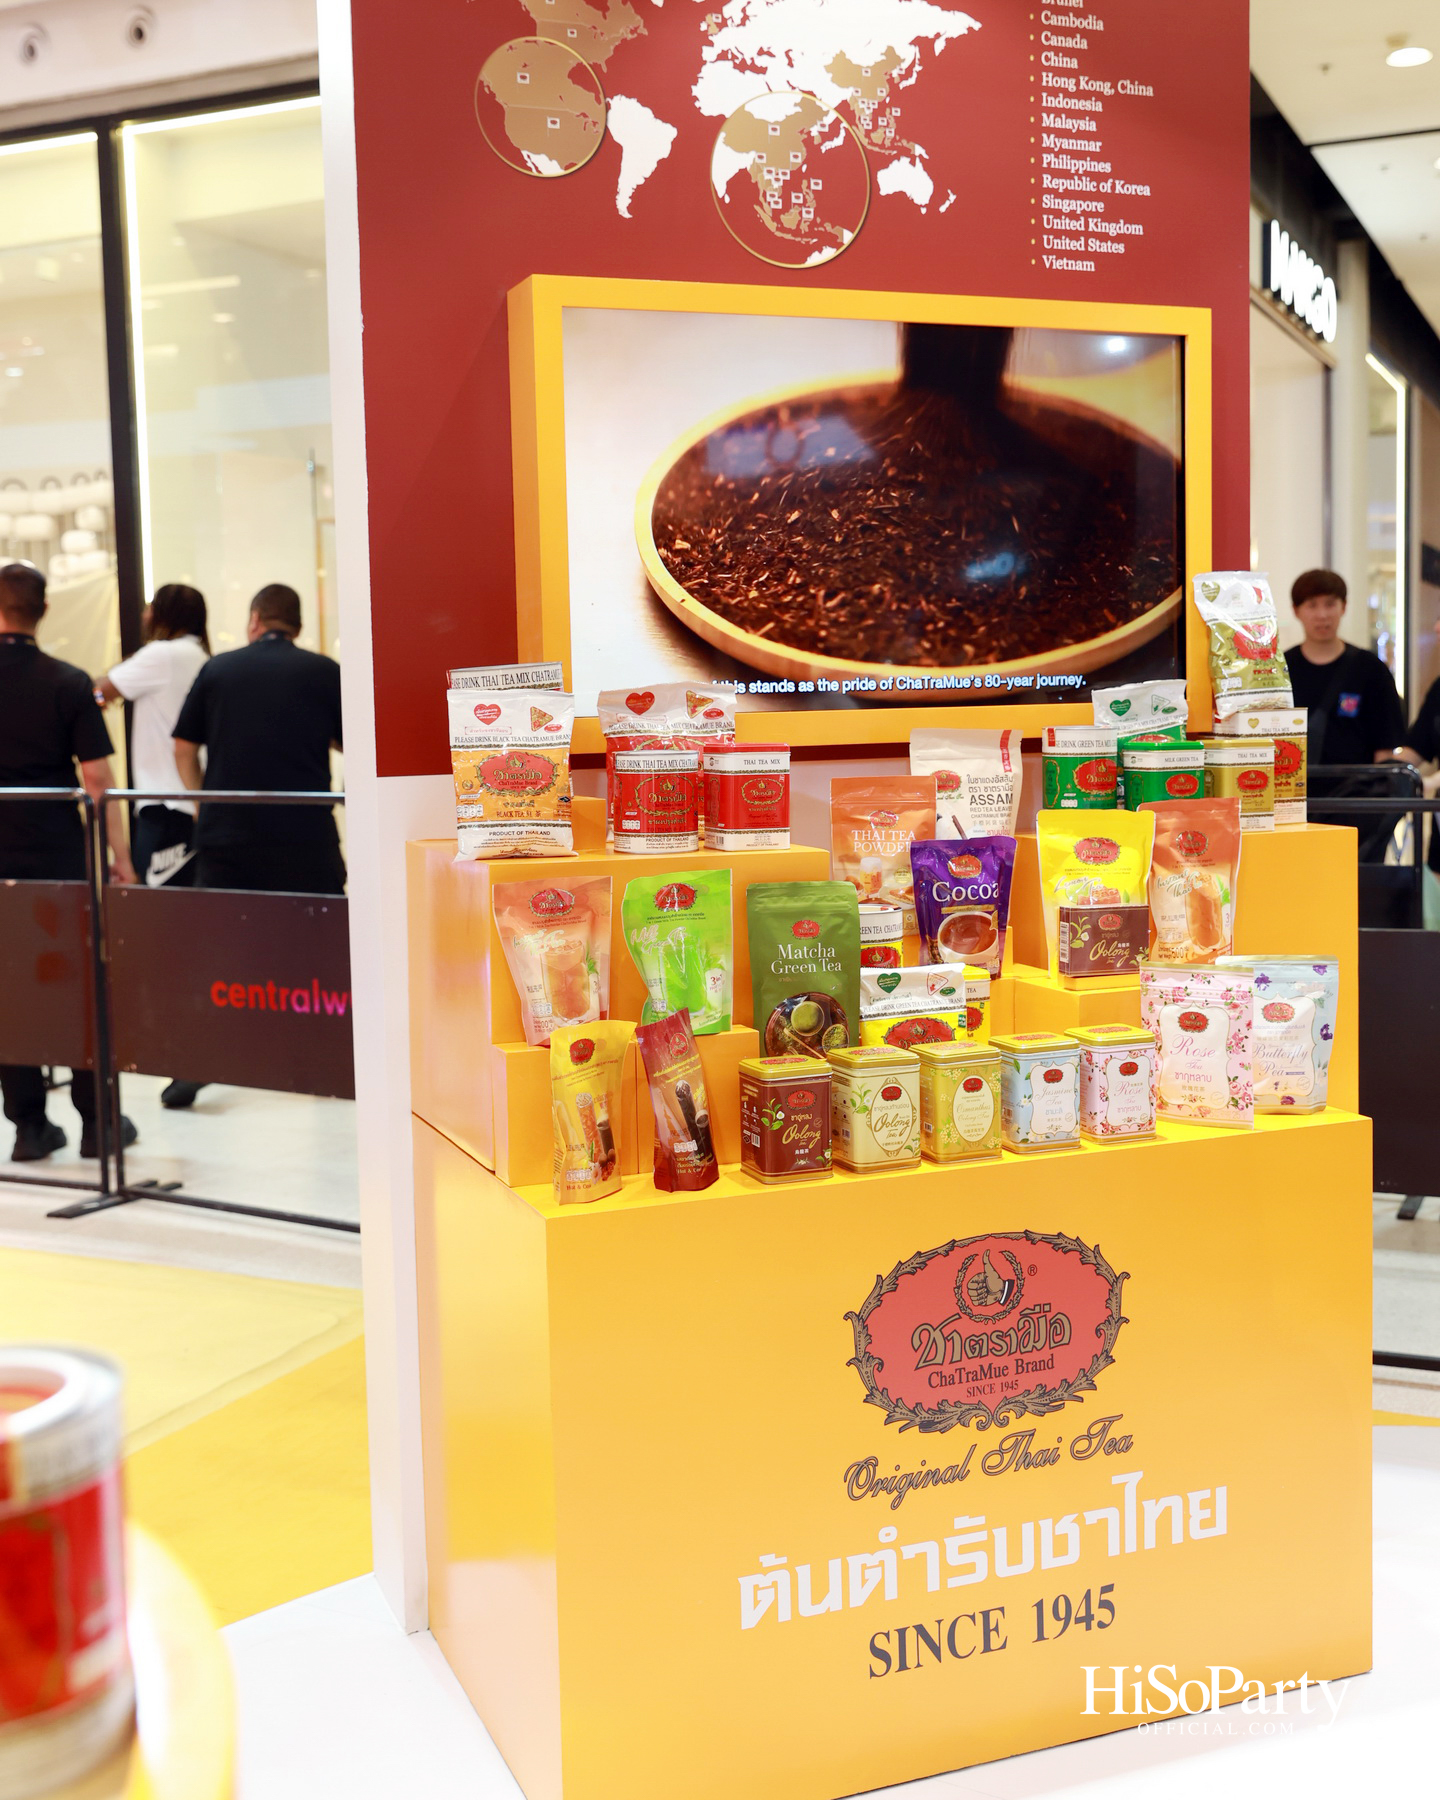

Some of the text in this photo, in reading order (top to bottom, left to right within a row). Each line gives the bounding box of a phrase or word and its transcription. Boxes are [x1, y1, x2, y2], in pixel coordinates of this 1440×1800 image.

[1041, 10, 1104, 31] Cambodia
[1041, 31, 1088, 49] Canada
[1041, 51, 1078, 69] China
[1042, 72, 1154, 97] Hong Kong, China
[1042, 92, 1103, 112] Indonesia
[1042, 113, 1097, 133] Malaysia
[1042, 133, 1102, 152] Myanmar
[1042, 153, 1112, 174] Philippines
[1042, 174, 1151, 196] Republic of Korea
[1042, 194, 1105, 214] Singapore
[1042, 214, 1144, 236] United Kingdom
[1043, 235, 1125, 254] United States
[1042, 255, 1095, 272] Vietnam
[461, 672, 530, 689] DRINK THAI TEA MIX
[749, 679, 795, 694] stands
[798, 681, 815, 693] as
[817, 678, 839, 692] the
[842, 677, 876, 694] pride
[880, 677, 894, 690] of
[984, 674, 1034, 690] 80-year
[1036, 673, 1087, 689] journey.
[627, 760, 678, 768] DRINK THAI TEA MIX
[970, 793, 1013, 806] ASSAM
[852, 830, 916, 840] THAI TEA
[932, 881, 999, 902] Cocoa
[873, 926, 883, 934] TEA
[778, 942, 836, 959] Matcha
[1089, 940, 1129, 967] Oolong
[771, 958, 842, 974] Green Tea
[210, 978, 352, 1016] centralw
[863, 1005, 880, 1013] PLEASE
[880, 1004, 895, 1012] DRINK
[1170, 1034, 1216, 1058] Rose
[1252, 1042, 1308, 1064] Butterfly
[1175, 1072, 1212, 1083] ชากุหลาบ
[1259, 1060, 1284, 1076] Pea
[1035, 1085, 1072, 1100] Jasmine
[1114, 1081, 1143, 1096] Rose
[874, 1113, 910, 1137] Oolong
[782, 1124, 821, 1149] Oolong
[911, 1303, 1071, 1371] ชาตรามือ
[928, 1354, 1055, 1388] ChaTraMue Brand
[966, 1380, 1019, 1398] SINCE 1945
[844, 1414, 1133, 1510] Original Thai Tea
[738, 1470, 1228, 1630] ต้นตำรับชาไทย
[869, 1583, 1116, 1679] SINCE 1945
